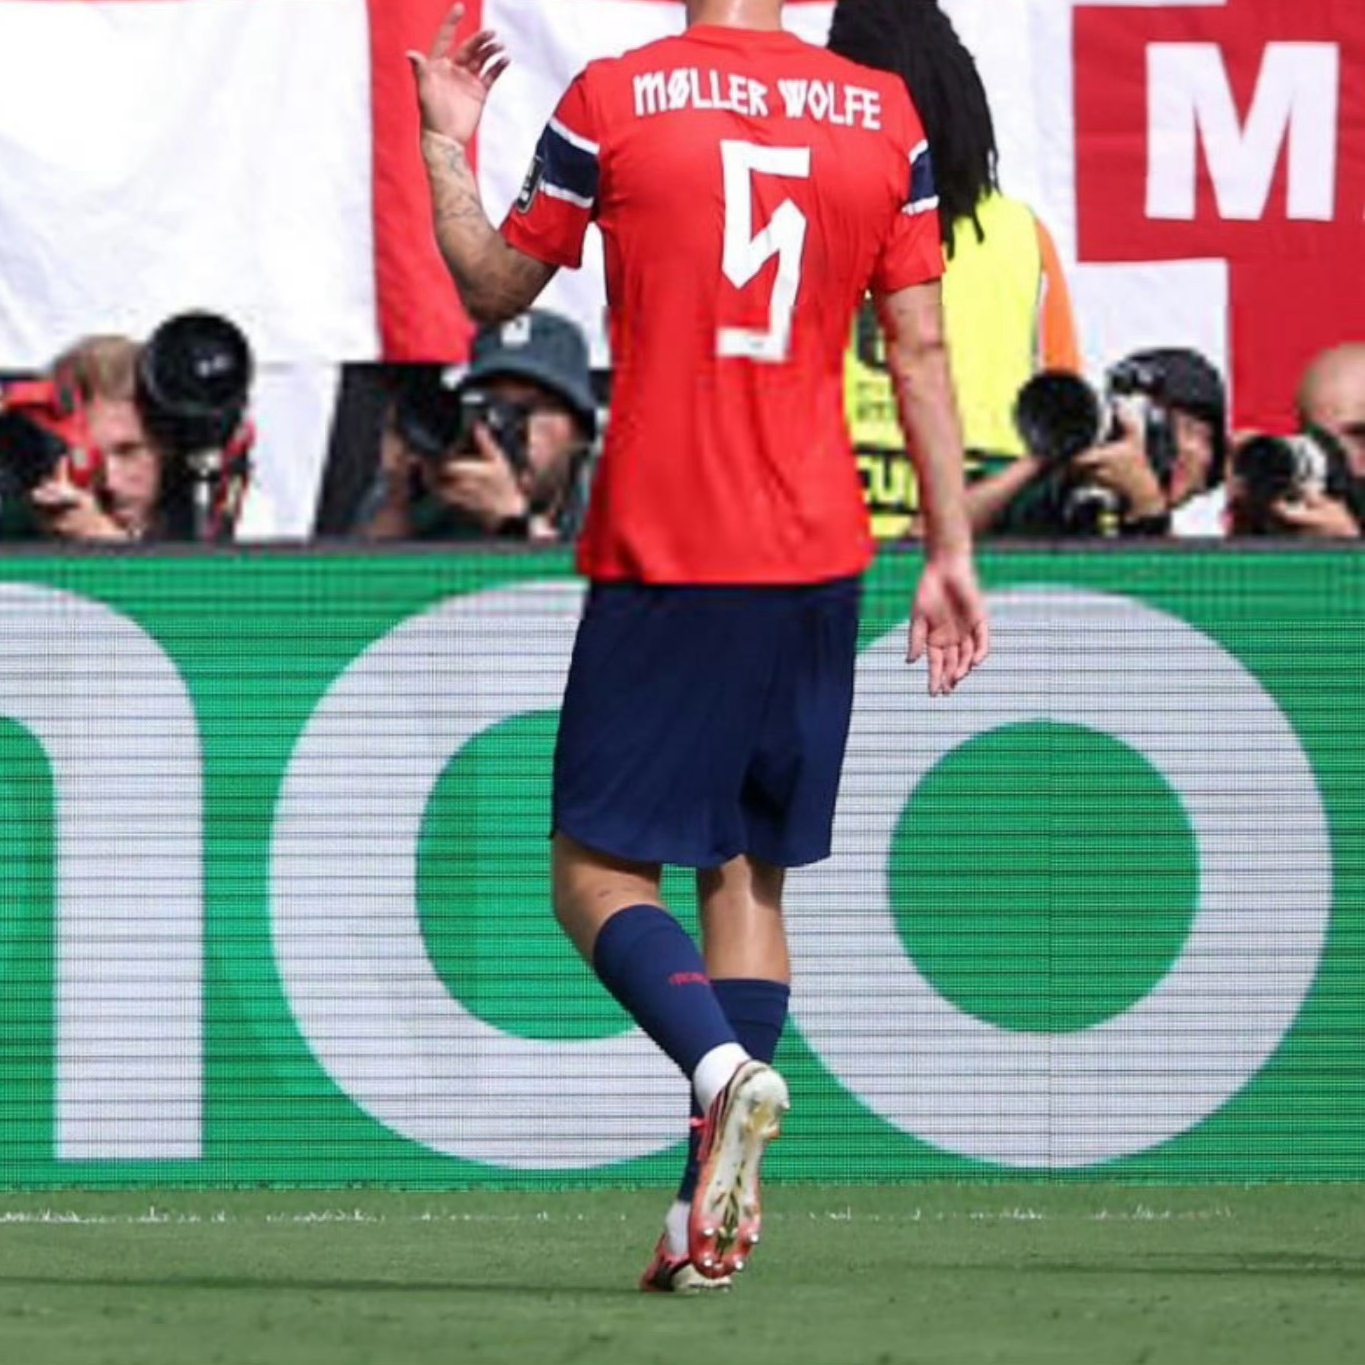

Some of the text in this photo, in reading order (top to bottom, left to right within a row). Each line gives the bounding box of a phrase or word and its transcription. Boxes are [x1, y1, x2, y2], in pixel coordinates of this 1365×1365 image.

[632, 67, 882, 132] MØLLER WOLFE
[715, 139, 810, 362] 5
